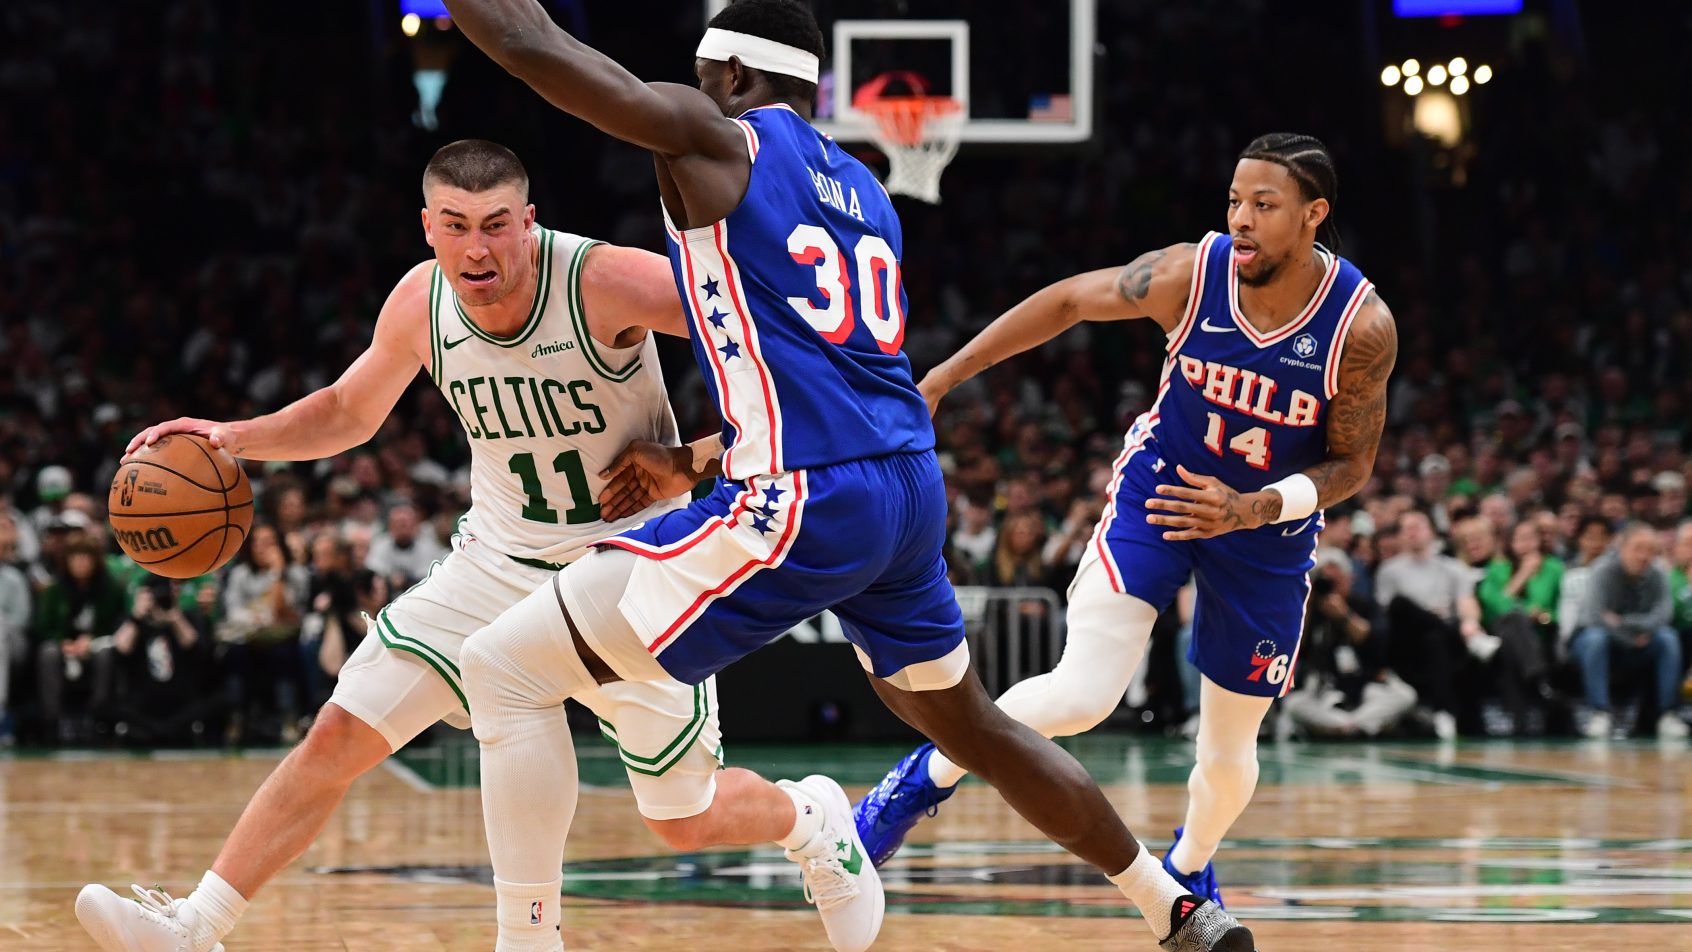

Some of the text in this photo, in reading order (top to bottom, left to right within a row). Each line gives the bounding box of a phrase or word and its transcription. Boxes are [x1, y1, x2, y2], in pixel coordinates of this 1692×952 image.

[787, 224, 905, 356] 30
[531, 340, 575, 359] Amica
[1279, 356, 1322, 371] crypto.com
[450, 376, 607, 440] CELTICS
[1178, 353, 1321, 427] PHILA
[1203, 412, 1272, 471] 14
[508, 449, 602, 525] 11
[113, 524, 179, 553] Wilso
[1247, 653, 1289, 685] 76
